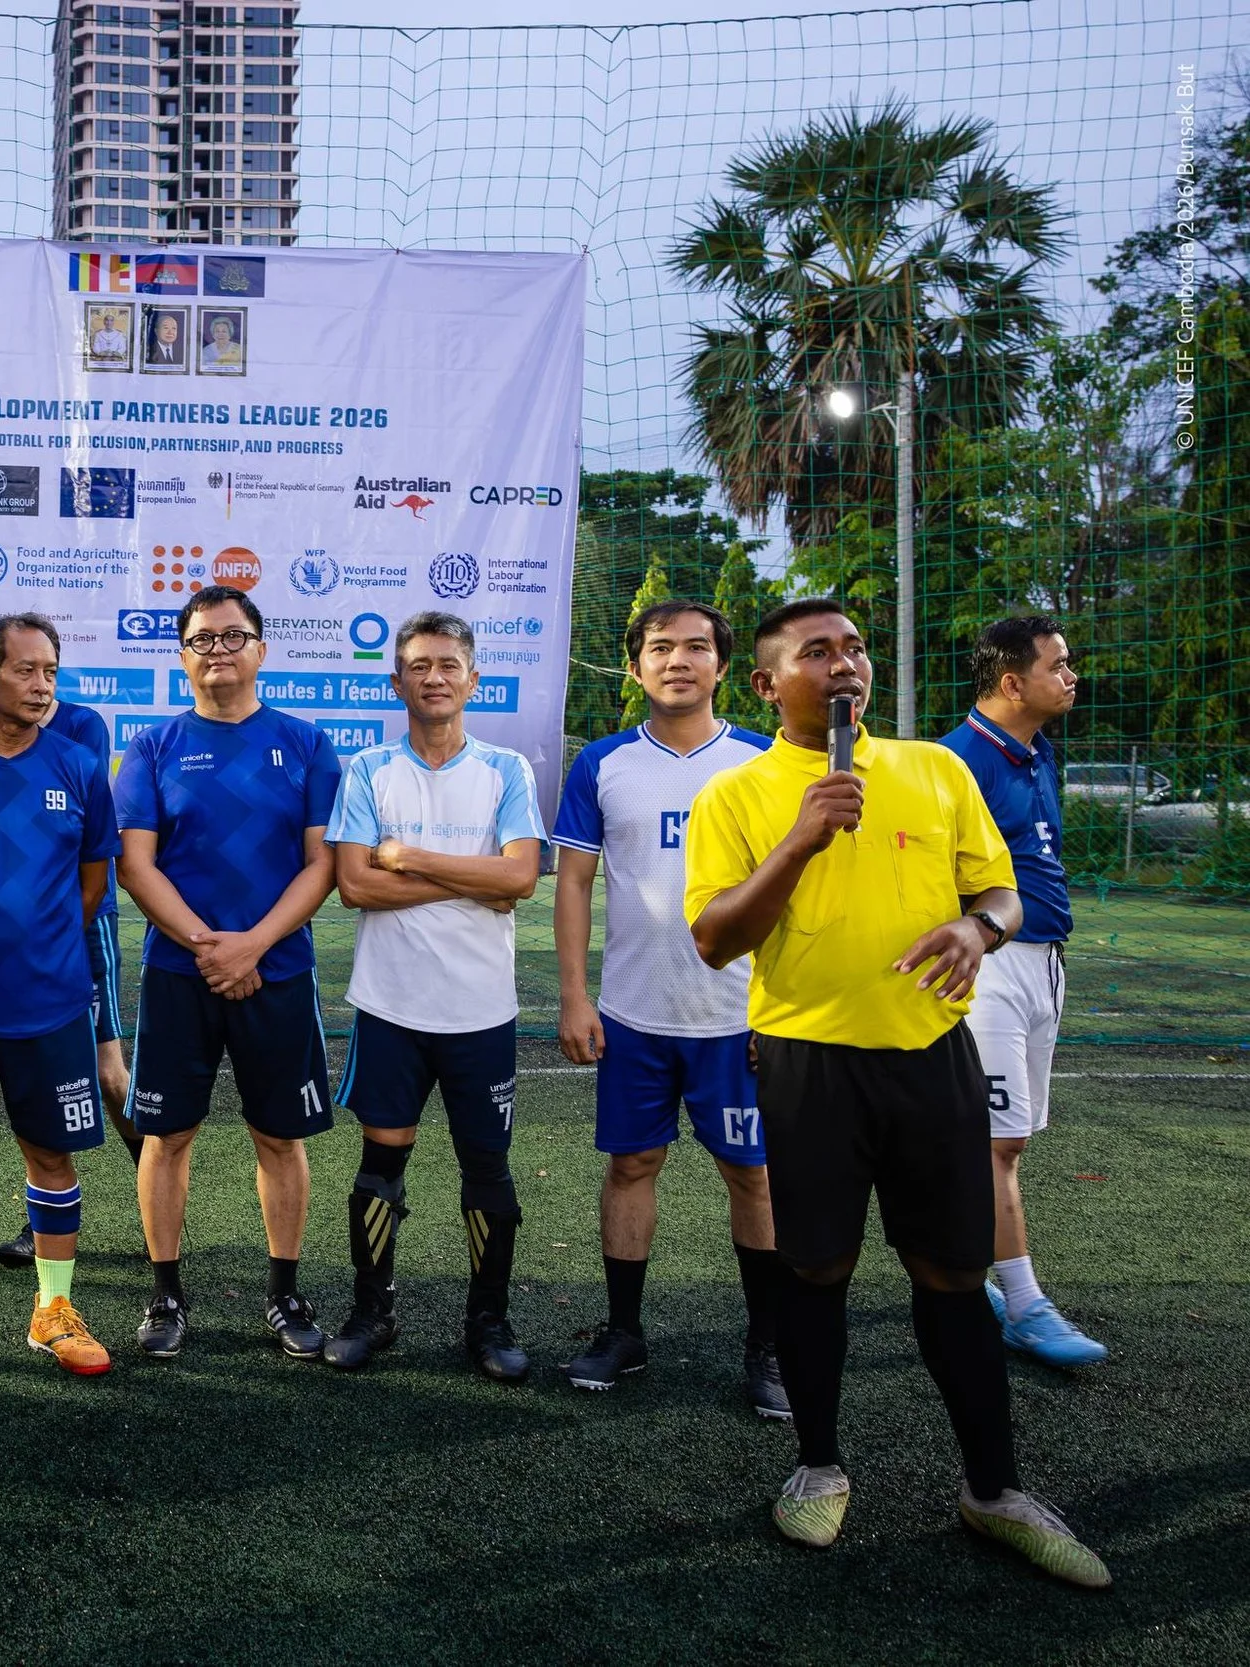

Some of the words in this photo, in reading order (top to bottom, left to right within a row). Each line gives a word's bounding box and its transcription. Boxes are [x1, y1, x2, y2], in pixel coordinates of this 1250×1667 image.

[112, 400, 230, 425] PARTNERS
[239, 404, 321, 427] LEAGUE
[330, 406, 388, 429] 2026
[48, 435, 71, 449] FOR
[244, 439, 272, 453] AND
[277, 441, 344, 455] PROGRESS
[235, 472, 263, 481] Embassy
[242, 482, 253, 490] the
[255, 482, 278, 491] Federal
[280, 483, 306, 493] Republic
[316, 484, 345, 494] Germany
[354, 475, 451, 493] Australian
[8, 497, 35, 507] GROUP
[137, 494, 173, 505] European
[174, 495, 197, 504] Union
[235, 491, 258, 499] Phnom
[260, 492, 276, 500] Penh
[354, 493, 386, 509] Aid
[469, 485, 563, 506] CAPRED
[16, 546, 45, 558] Food
[49, 547, 70, 558] and
[74, 548, 139, 561] Agriculture
[305, 549, 325, 557] WFP
[16, 561, 90, 575] Organization
[95, 563, 108, 574] of
[111, 564, 130, 575] the
[213, 561, 261, 578] UNFPA
[343, 565, 377, 576] World
[380, 566, 407, 576] Food
[488, 558, 548, 570] International
[444, 561, 466, 585] ILO
[488, 570, 524, 581] Labour
[16, 577, 55, 588] United
[58, 577, 104, 589] Nations
[343, 577, 407, 589] Programme
[488, 582, 547, 594] Organization
[264, 618, 343, 630] SERVATION
[72, 634, 97, 642] GmbH
[264, 630, 344, 642] RNATIONAL
[121, 646, 141, 654] Until
[287, 649, 342, 660] Cambodia
[79, 676, 117, 696] WVI
[256, 680, 316, 699] Toutes
[322, 679, 334, 700] à
[340, 679, 398, 702] l'école
[468, 685, 507, 705] SCO
[180, 753, 204, 763] unicef
[271, 748, 283, 767] 11
[45, 789, 67, 811] 99
[380, 820, 410, 834] nicef
[56, 1078, 81, 1093] unicef
[300, 1079, 324, 1118] 11
[986, 1075, 1010, 1111] 5
[63, 1098, 95, 1132] 99
